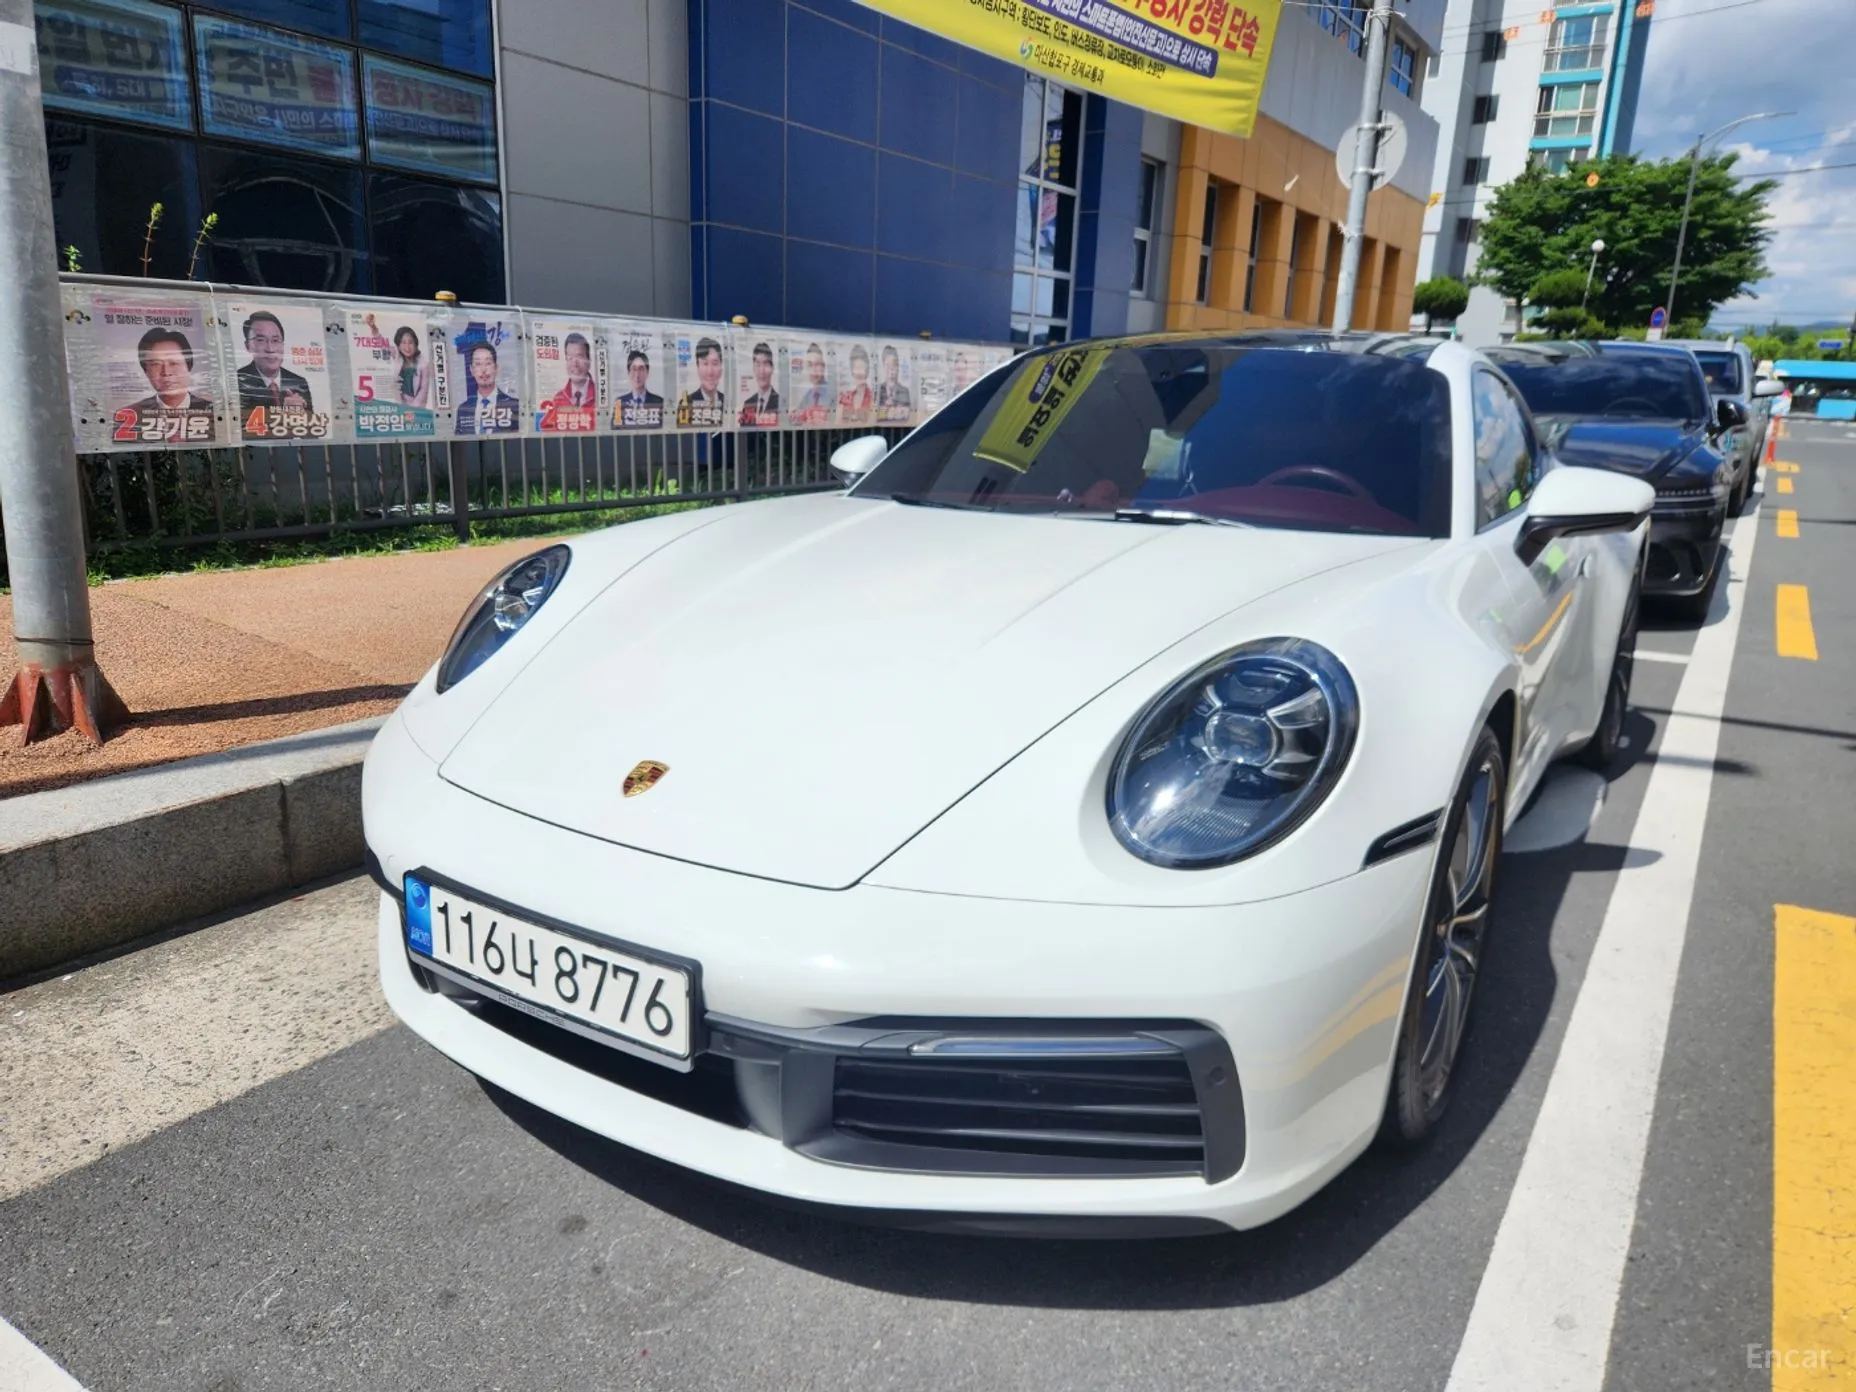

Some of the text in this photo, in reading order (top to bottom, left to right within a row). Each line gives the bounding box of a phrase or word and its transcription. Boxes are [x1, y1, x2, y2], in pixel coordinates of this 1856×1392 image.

[1224, 6, 1260, 58] 단속
[1179, 42, 1199, 68] 상시
[1195, 49, 1213, 74] 단속
[358, 375, 374, 402] 5
[113, 408, 138, 441] 2
[141, 415, 210, 440] 강기윤
[245, 405, 268, 436] 4
[269, 413, 330, 437] 강명상
[359, 414, 405, 433] 박정임
[481, 407, 513, 428] 김강
[436, 901, 674, 1037] 116나 8776
